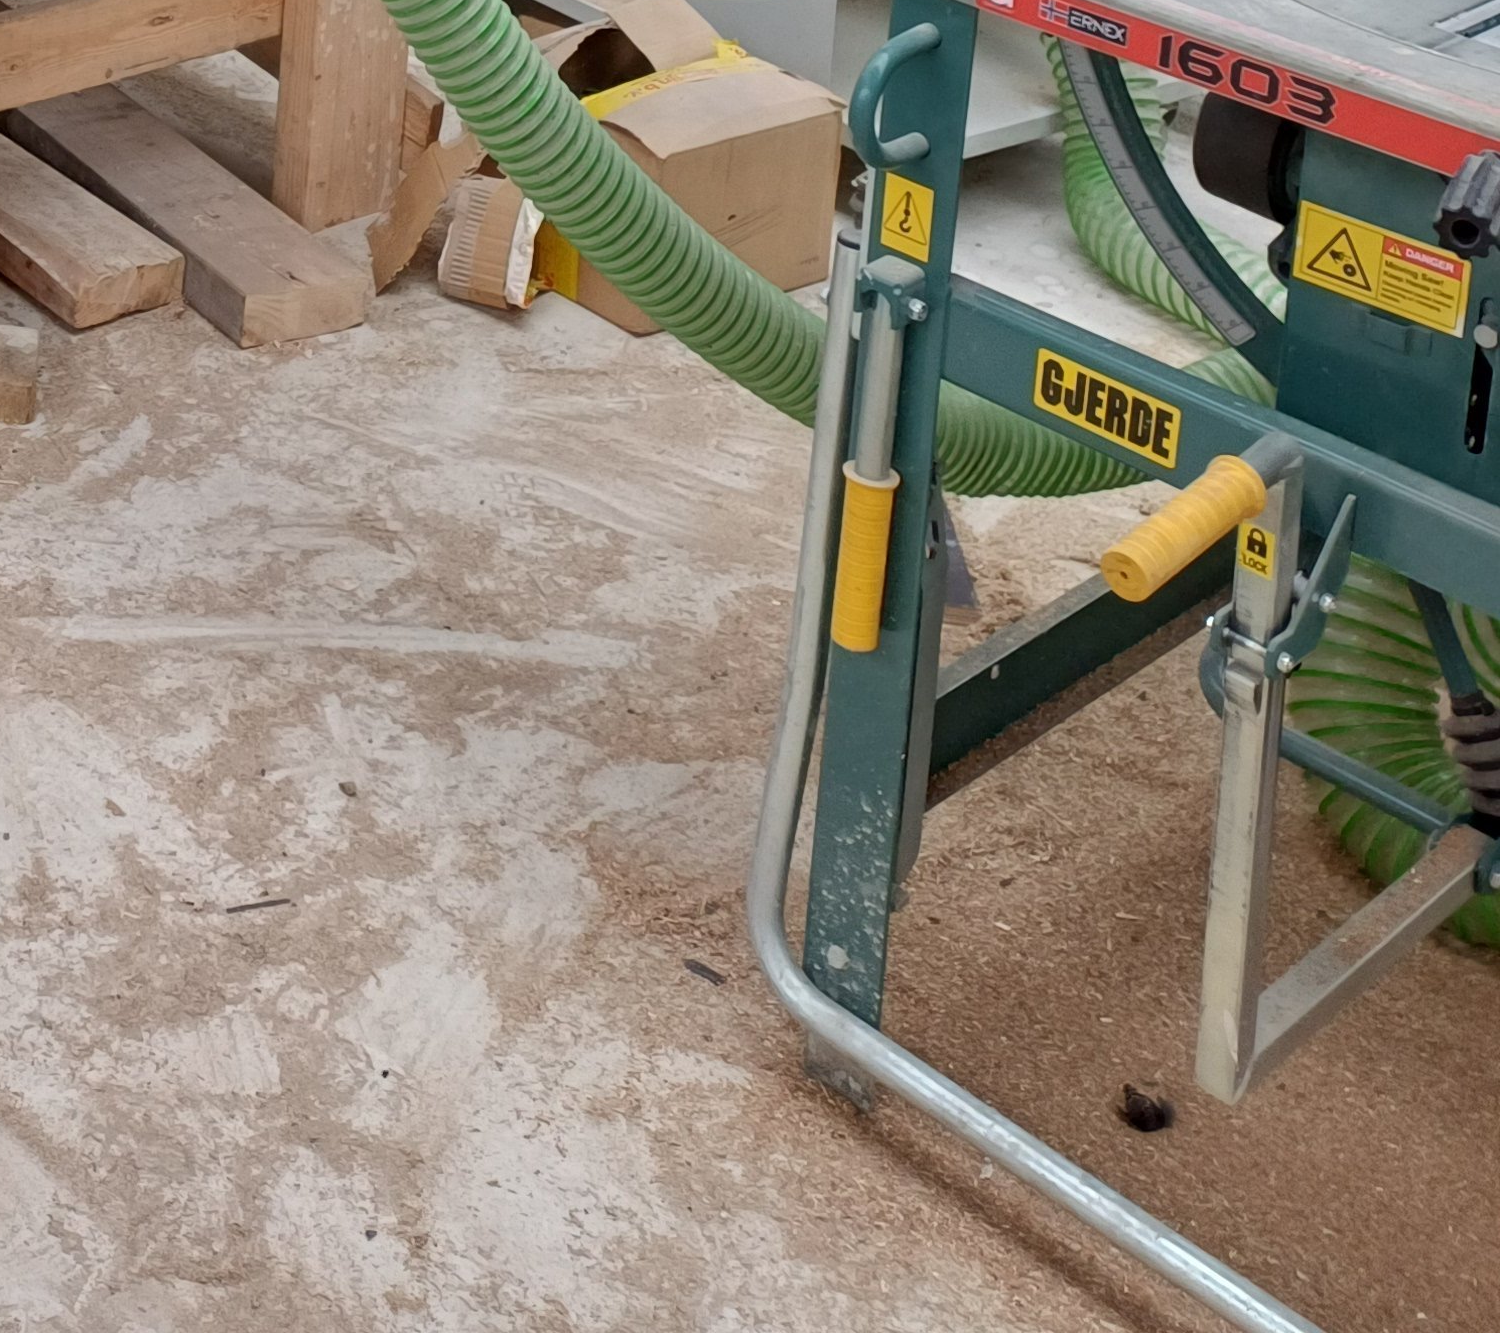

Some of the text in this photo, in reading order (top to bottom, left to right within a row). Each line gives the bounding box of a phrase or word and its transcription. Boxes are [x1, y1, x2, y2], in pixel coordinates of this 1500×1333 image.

[1158, 34, 1337, 126] 1603
[1405, 247, 1456, 274] DANGER
[1040, 358, 1174, 460] GJERDE
